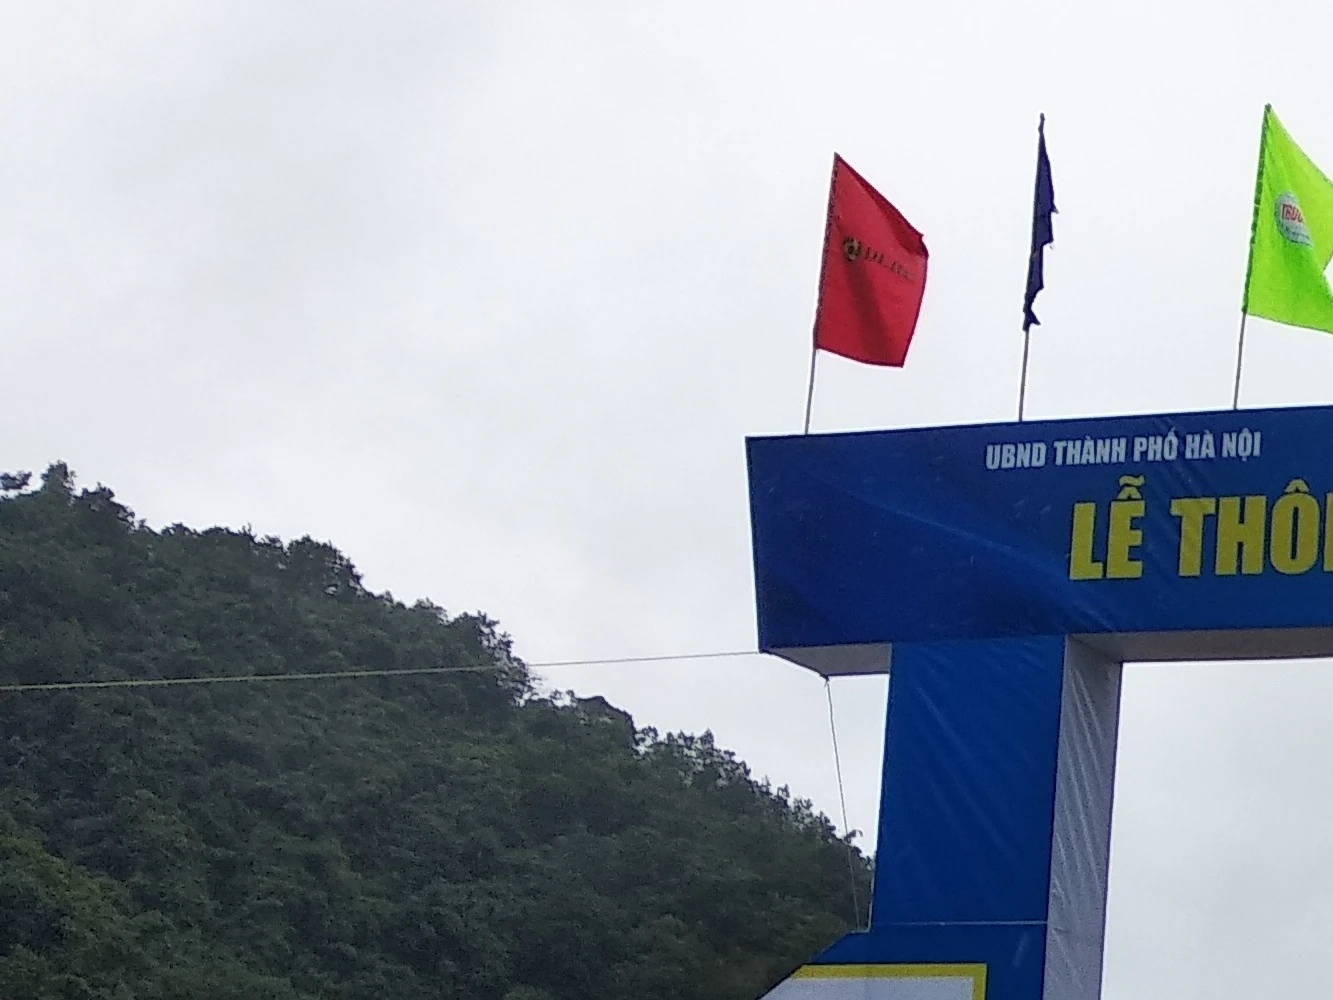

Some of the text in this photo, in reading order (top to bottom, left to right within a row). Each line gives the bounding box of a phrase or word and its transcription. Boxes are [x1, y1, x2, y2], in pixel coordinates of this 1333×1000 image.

[985, 427, 1262, 470] UBND THÀNH PHỐ HÀ NỘI
[1068, 474, 1148, 582] LỄ
